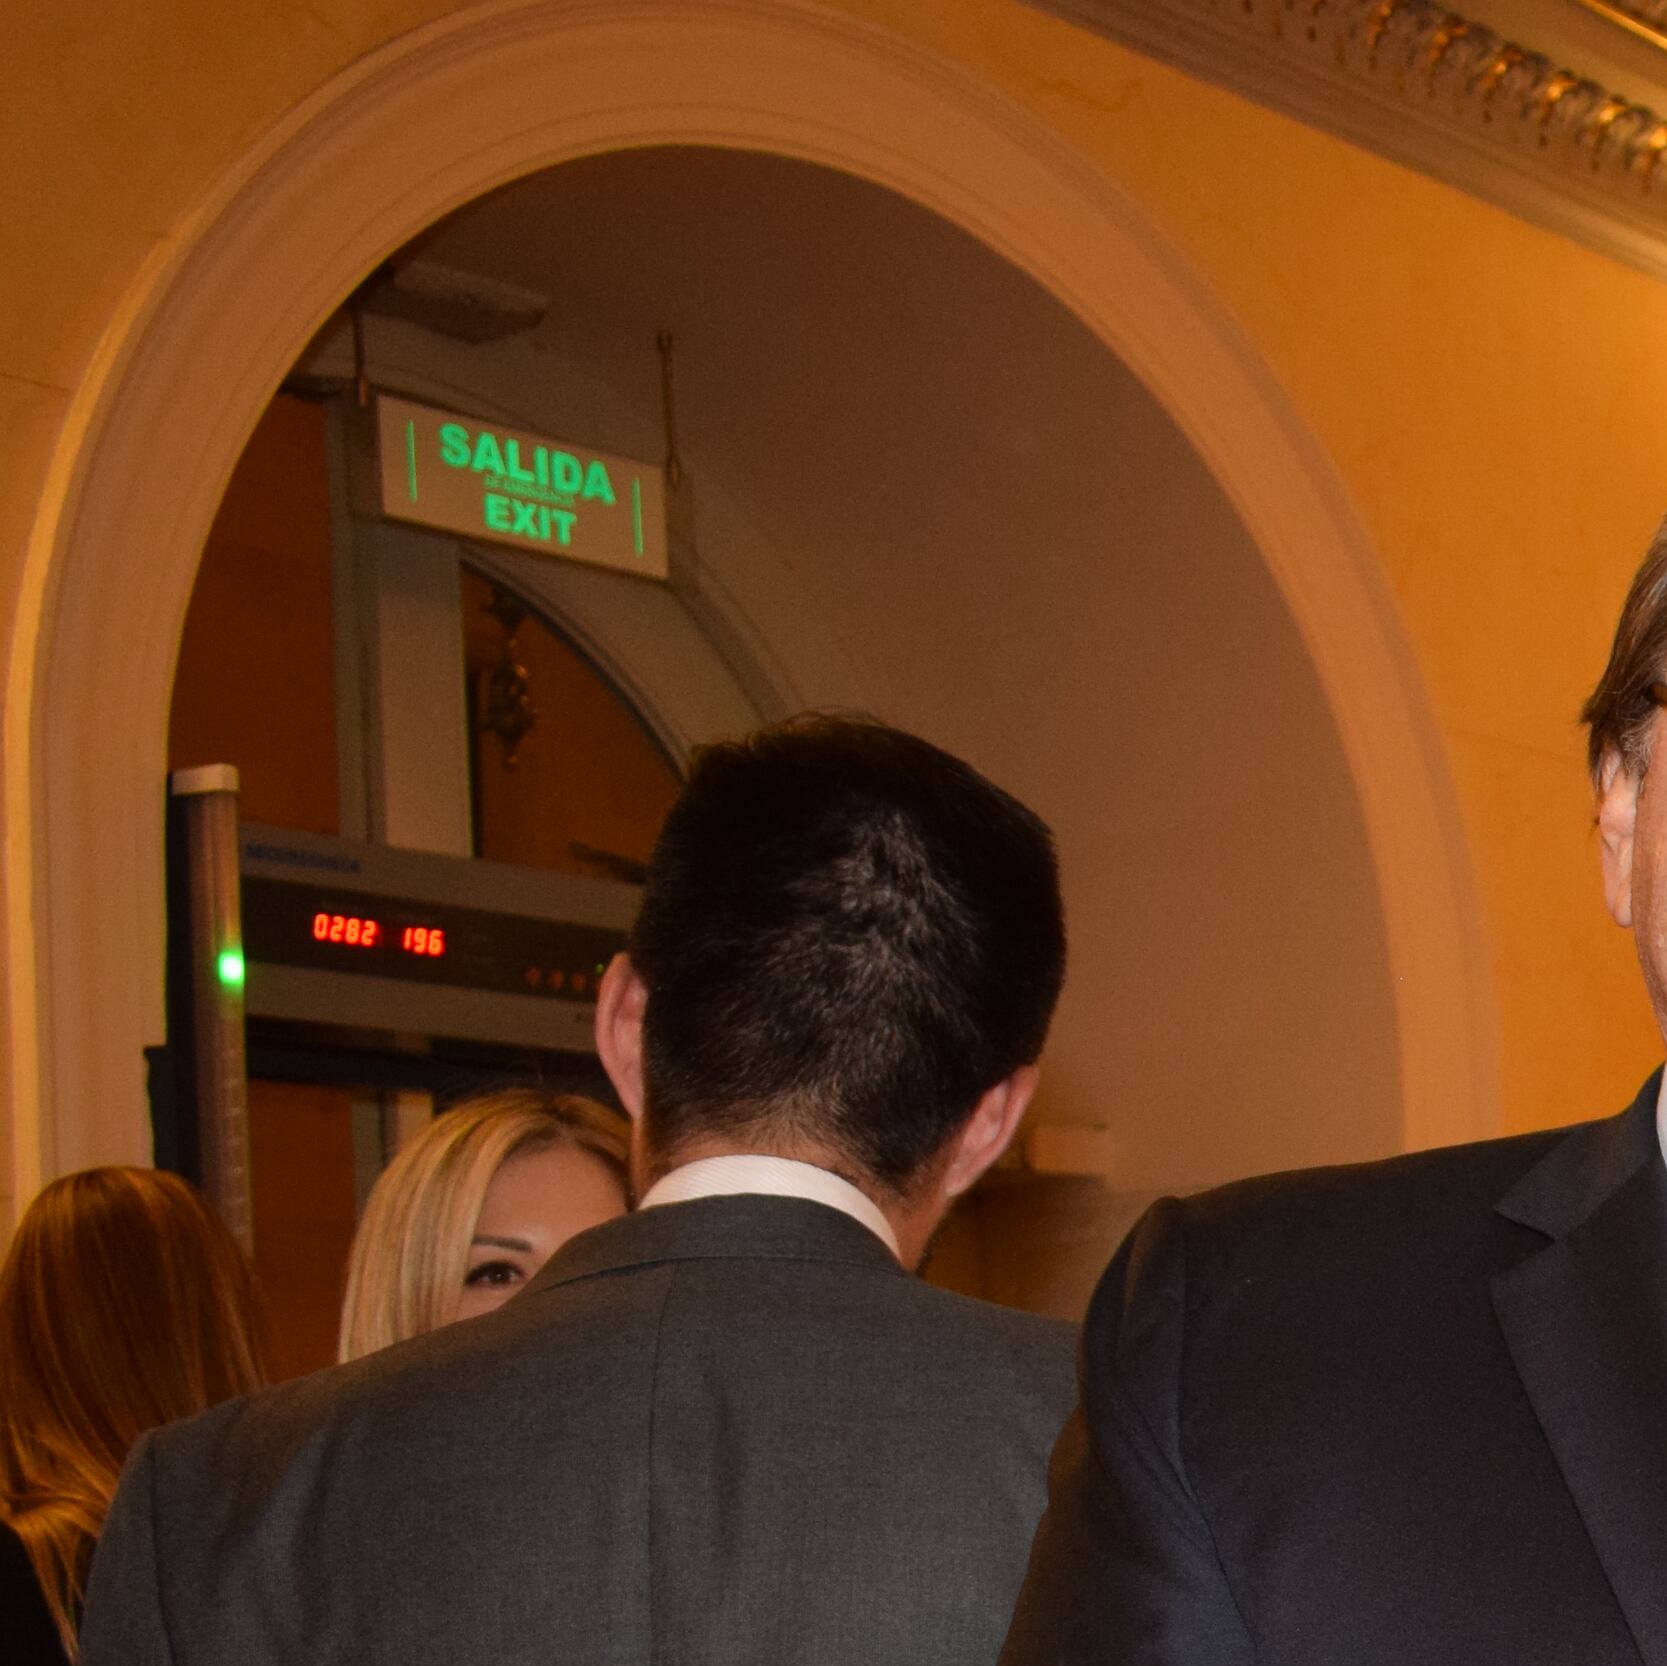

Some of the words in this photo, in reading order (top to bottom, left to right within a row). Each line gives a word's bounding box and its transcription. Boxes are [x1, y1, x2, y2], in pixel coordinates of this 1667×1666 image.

[439, 423, 616, 506] SALIDA
[484, 493, 577, 545] EXIT
[312, 912, 379, 948] 0282
[402, 926, 446, 957] 196
